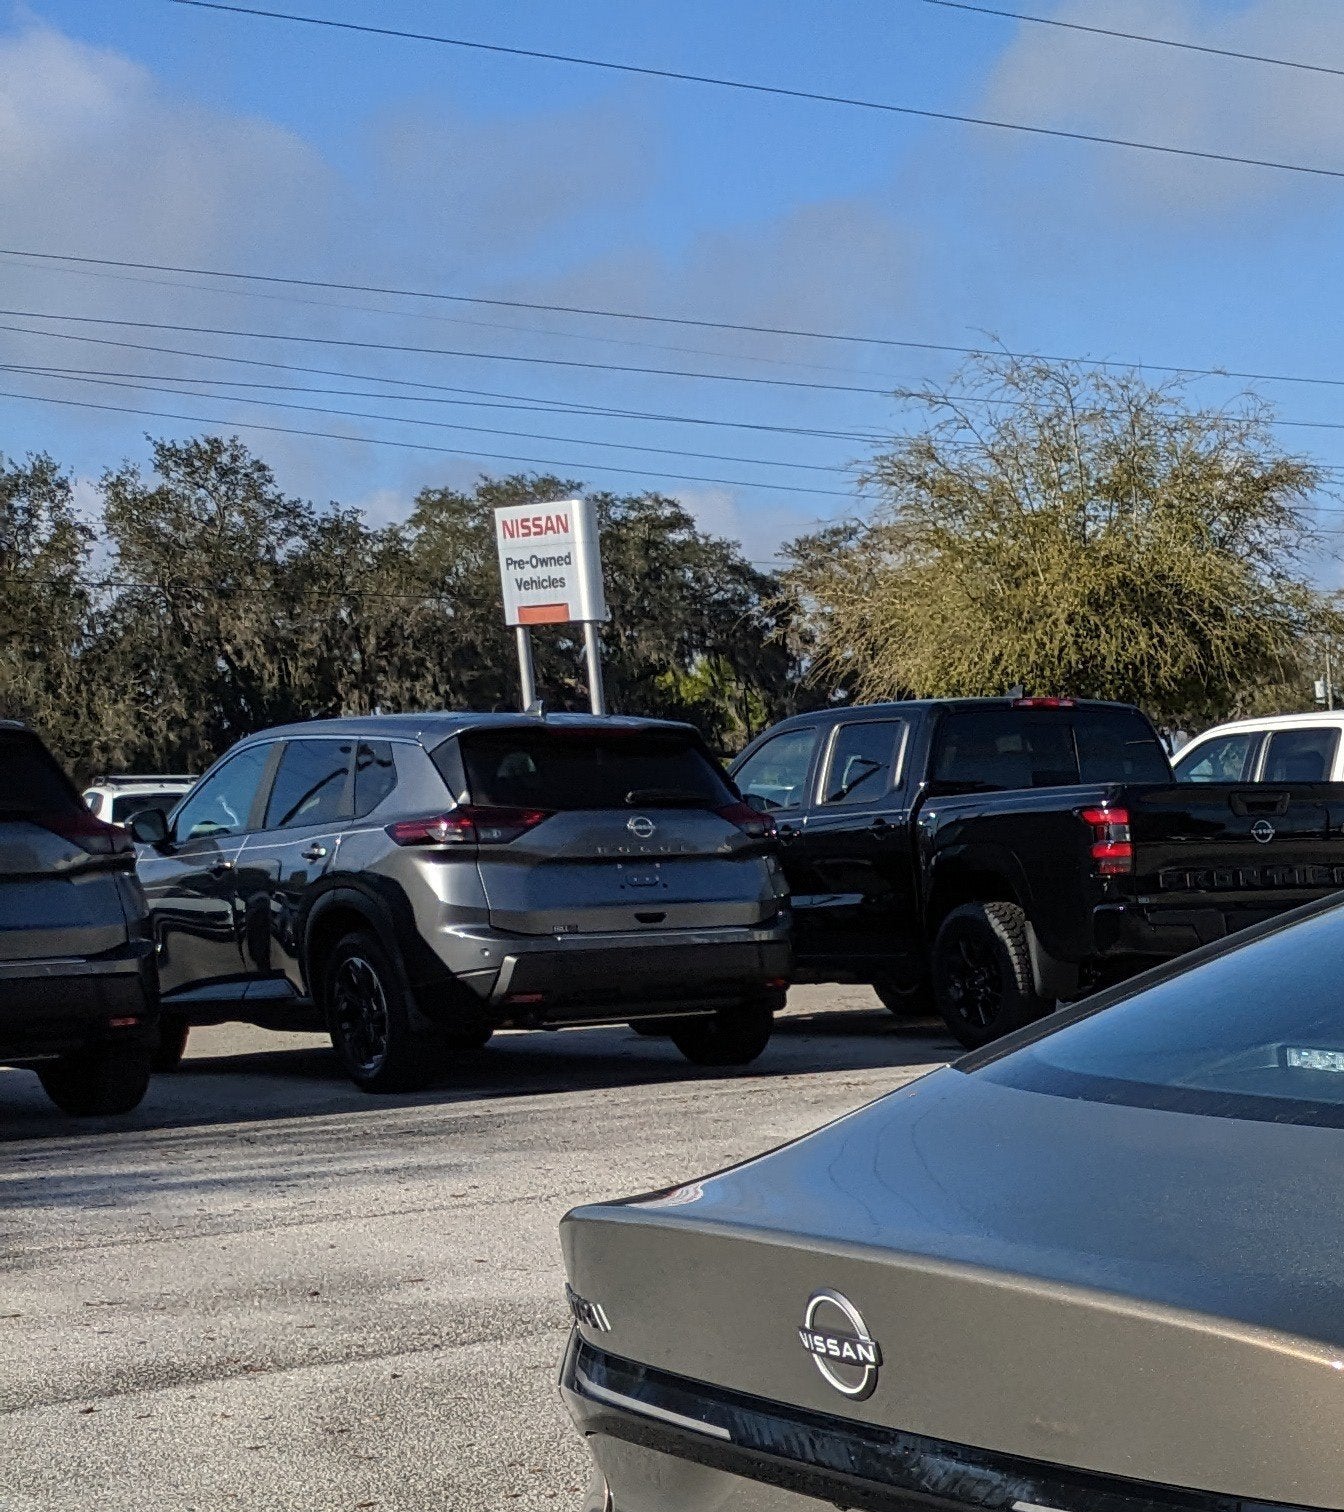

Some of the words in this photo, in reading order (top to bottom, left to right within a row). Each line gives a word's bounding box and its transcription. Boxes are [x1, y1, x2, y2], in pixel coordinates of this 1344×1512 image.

[502, 514, 569, 539] NISSAN
[505, 552, 572, 571] Pre-Owned
[514, 575, 566, 592] Vehicles
[799, 1330, 876, 1363] NISSAN
